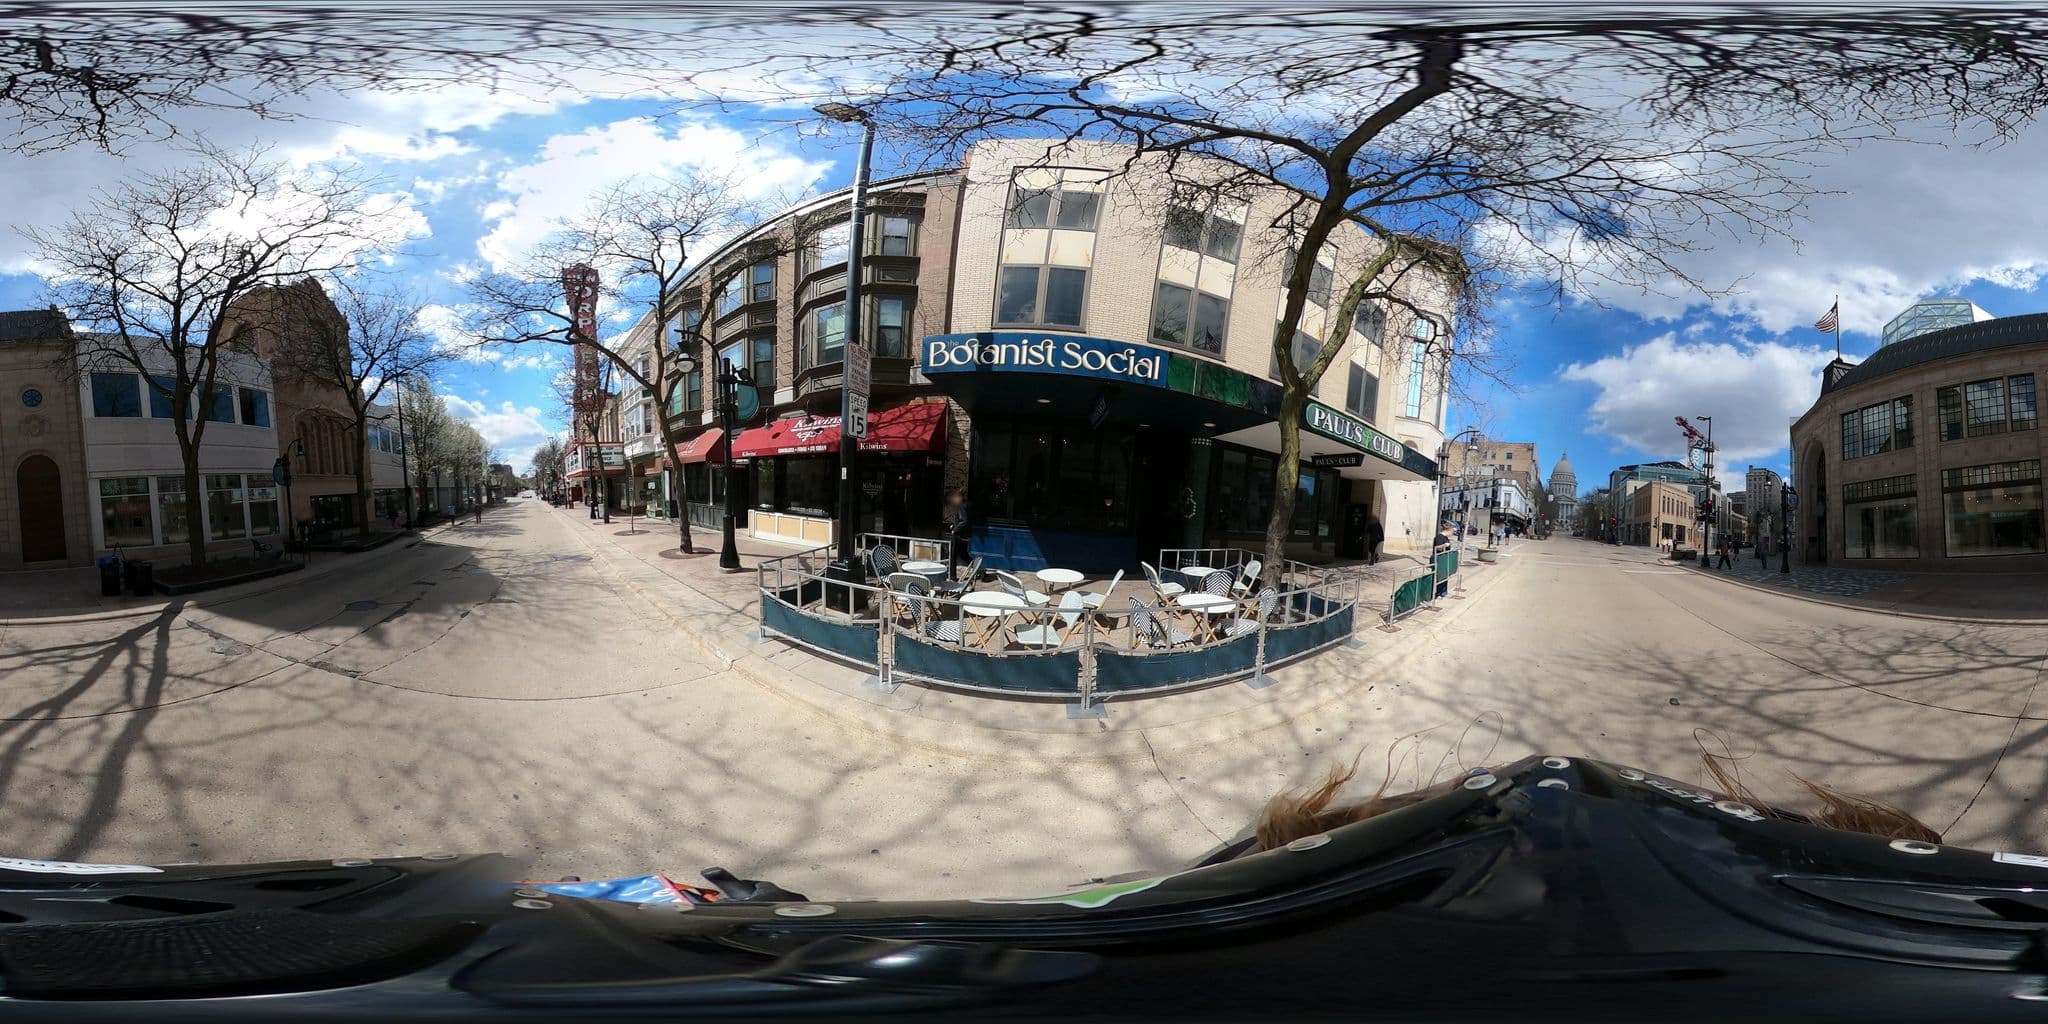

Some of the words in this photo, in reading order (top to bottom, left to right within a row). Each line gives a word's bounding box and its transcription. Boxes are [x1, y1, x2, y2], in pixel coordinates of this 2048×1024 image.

[929, 338, 1056, 367] Botanist
[1061, 342, 1161, 380] Social
[850, 395, 867, 409] SPEED
[851, 415, 864, 434] 15
[1313, 407, 1363, 443] PAUL'S
[1373, 435, 1401, 459] CLUB
[859, 442, 887, 450] Kilwins
[1338, 456, 1356, 464] CLUB
